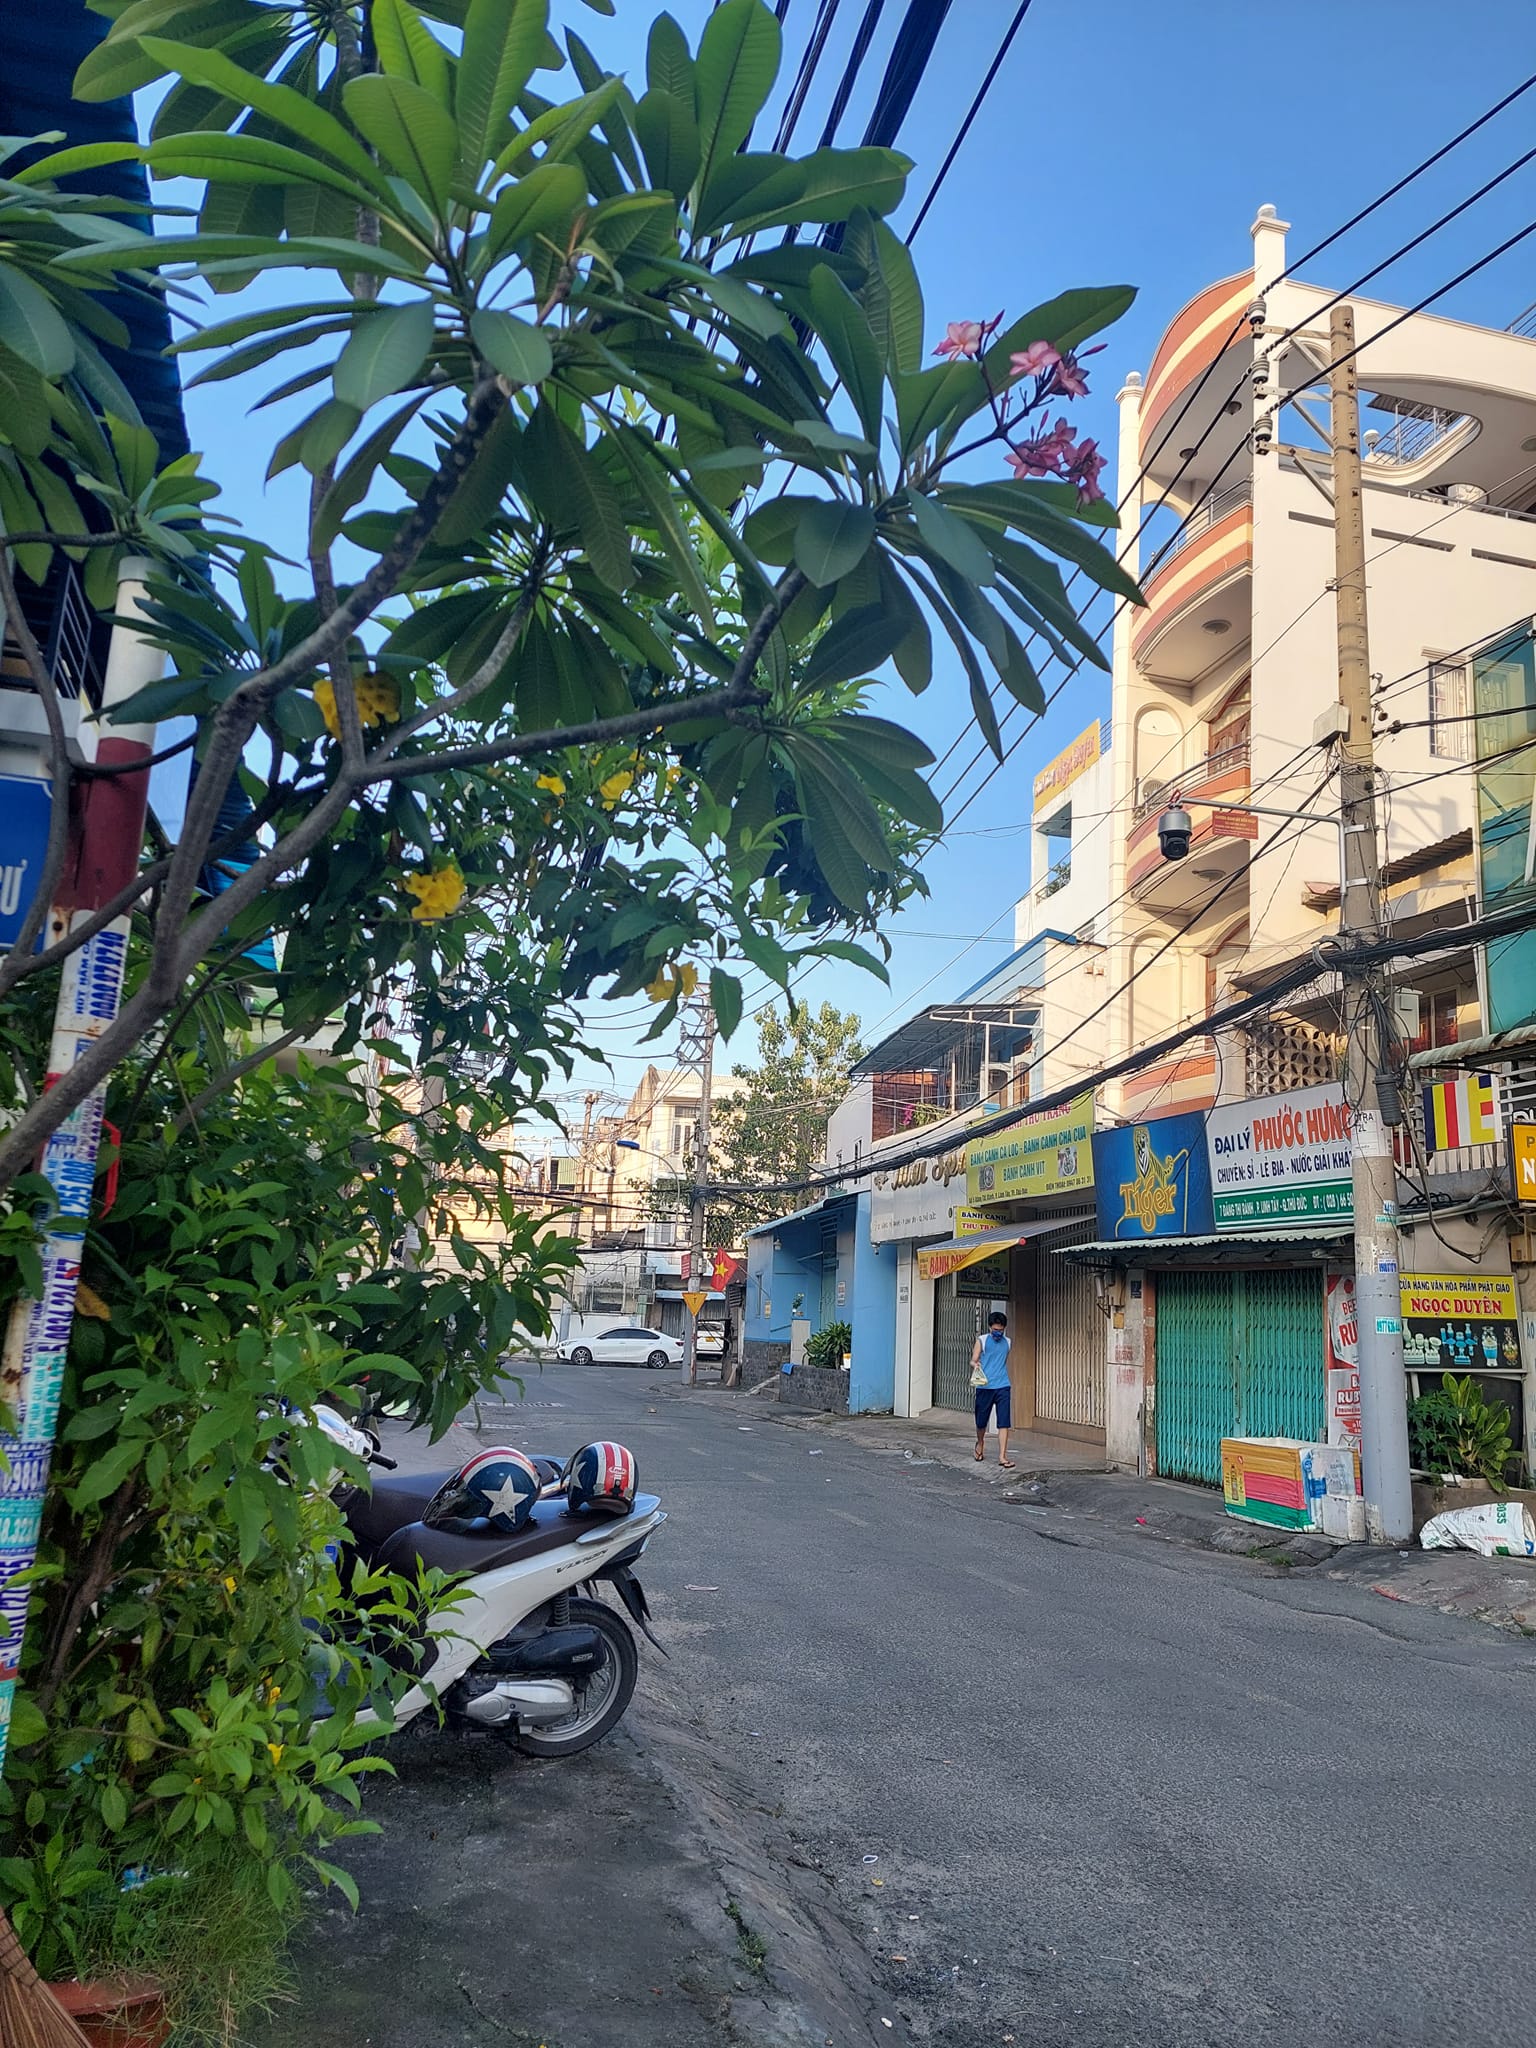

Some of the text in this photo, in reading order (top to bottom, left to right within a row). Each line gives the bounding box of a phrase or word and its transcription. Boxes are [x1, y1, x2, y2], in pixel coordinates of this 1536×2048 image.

[1040, 1133, 1058, 1150] CANH
[1073, 1125, 1087, 1142] CUA
[1215, 1135, 1234, 1158] ĐẠI
[1238, 1126, 1250, 1150] LÝ
[1252, 1103, 1304, 1153] PHƯỚC
[1019, 1164, 1036, 1178] CANH
[1272, 1160, 1285, 1177] BIA
[1290, 1152, 1312, 1174] NƯỚC
[1314, 1148, 1331, 1171] GIẢI
[1120, 1174, 1176, 1233] Tiger
[962, 1222, 978, 1230] THU
[930, 1252, 949, 1276] BÁNH
[1400, 1276, 1412, 1290] CỬA
[1412, 1278, 1430, 1290] HÀNG
[1430, 1279, 1444, 1291] VĂN
[1460, 1278, 1476, 1292] PHẨM
[1478, 1281, 1494, 1294] PHẬT
[1496, 1281, 1510, 1292] GIÁO
[1342, 1299, 1357, 1316] BEE
[1411, 1296, 1502, 1316] NGỌC DUYÊN
